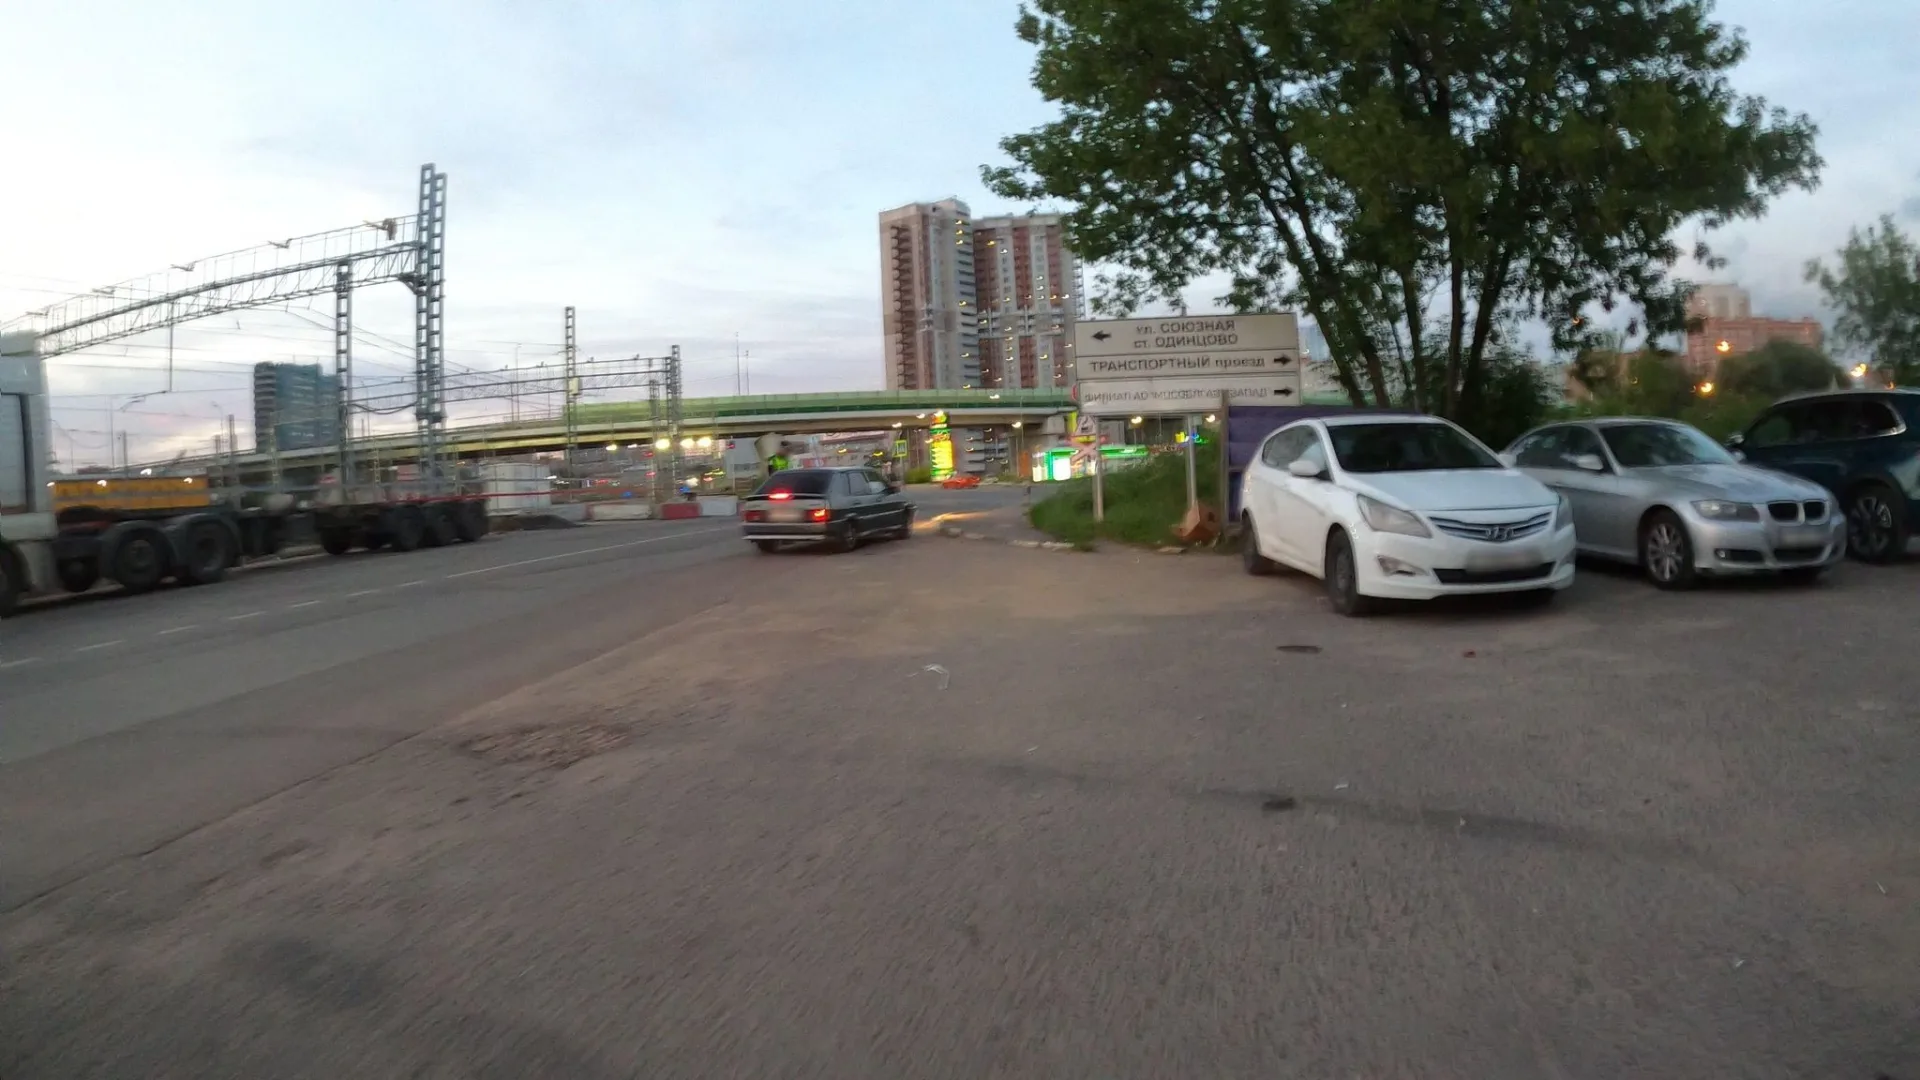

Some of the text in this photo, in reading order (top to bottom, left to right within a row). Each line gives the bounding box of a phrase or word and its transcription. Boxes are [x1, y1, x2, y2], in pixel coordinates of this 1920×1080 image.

[1136, 320, 1235, 334] ул. СОЮЗНАЯ
[1155, 333, 1238, 349] ОДИНЦОВО
[1089, 355, 1265, 373] ТРАНСПОРТНЫЙ проезд
